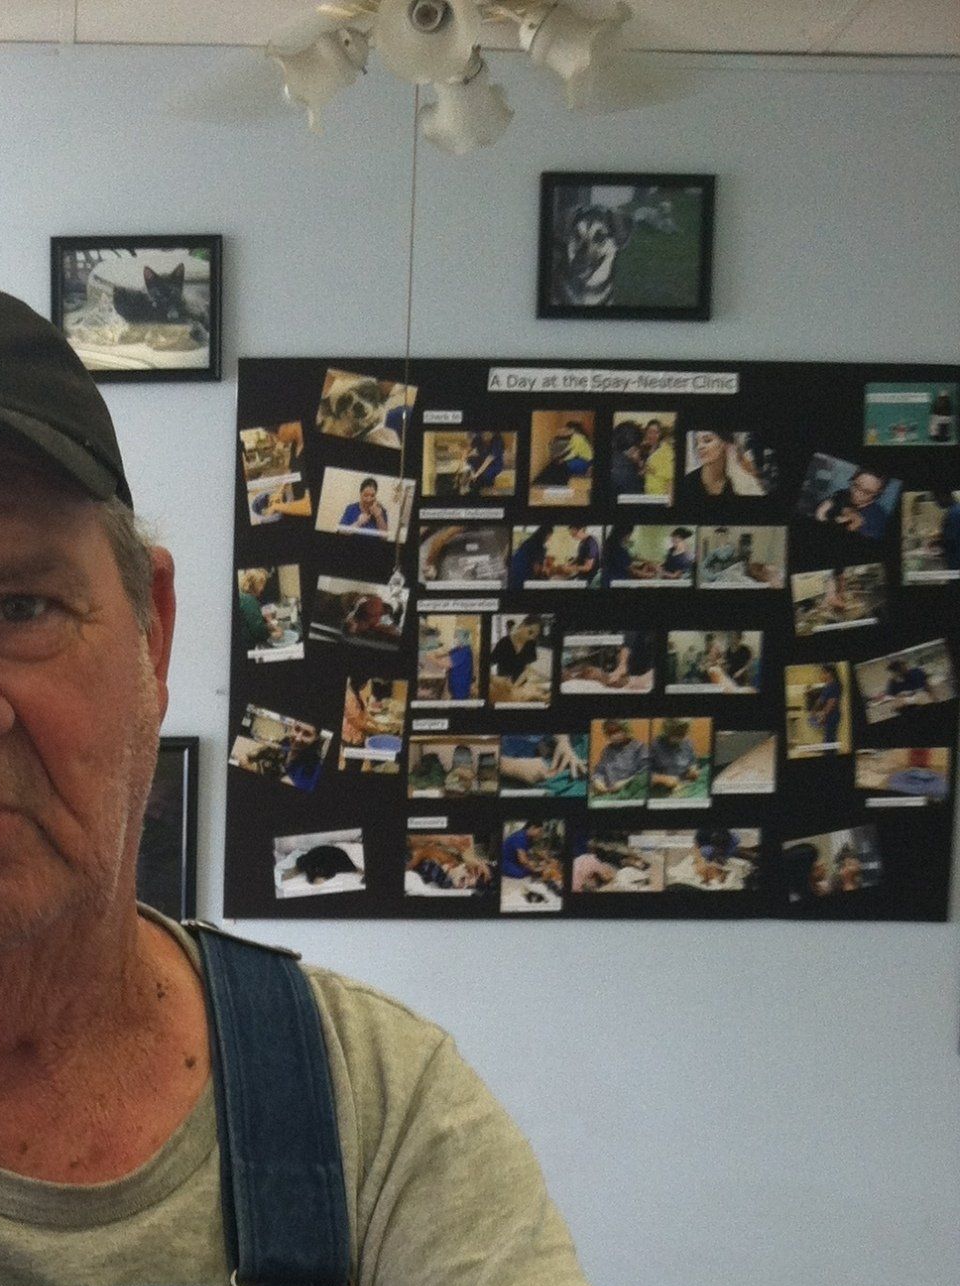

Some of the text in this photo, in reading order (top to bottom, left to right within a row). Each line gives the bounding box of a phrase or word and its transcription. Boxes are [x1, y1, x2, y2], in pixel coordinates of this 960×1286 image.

[490, 374, 501, 387] A
[507, 374, 537, 391] Day
[542, 375, 558, 388] at
[562, 375, 588, 389] the
[691, 375, 737, 391] Clinic
